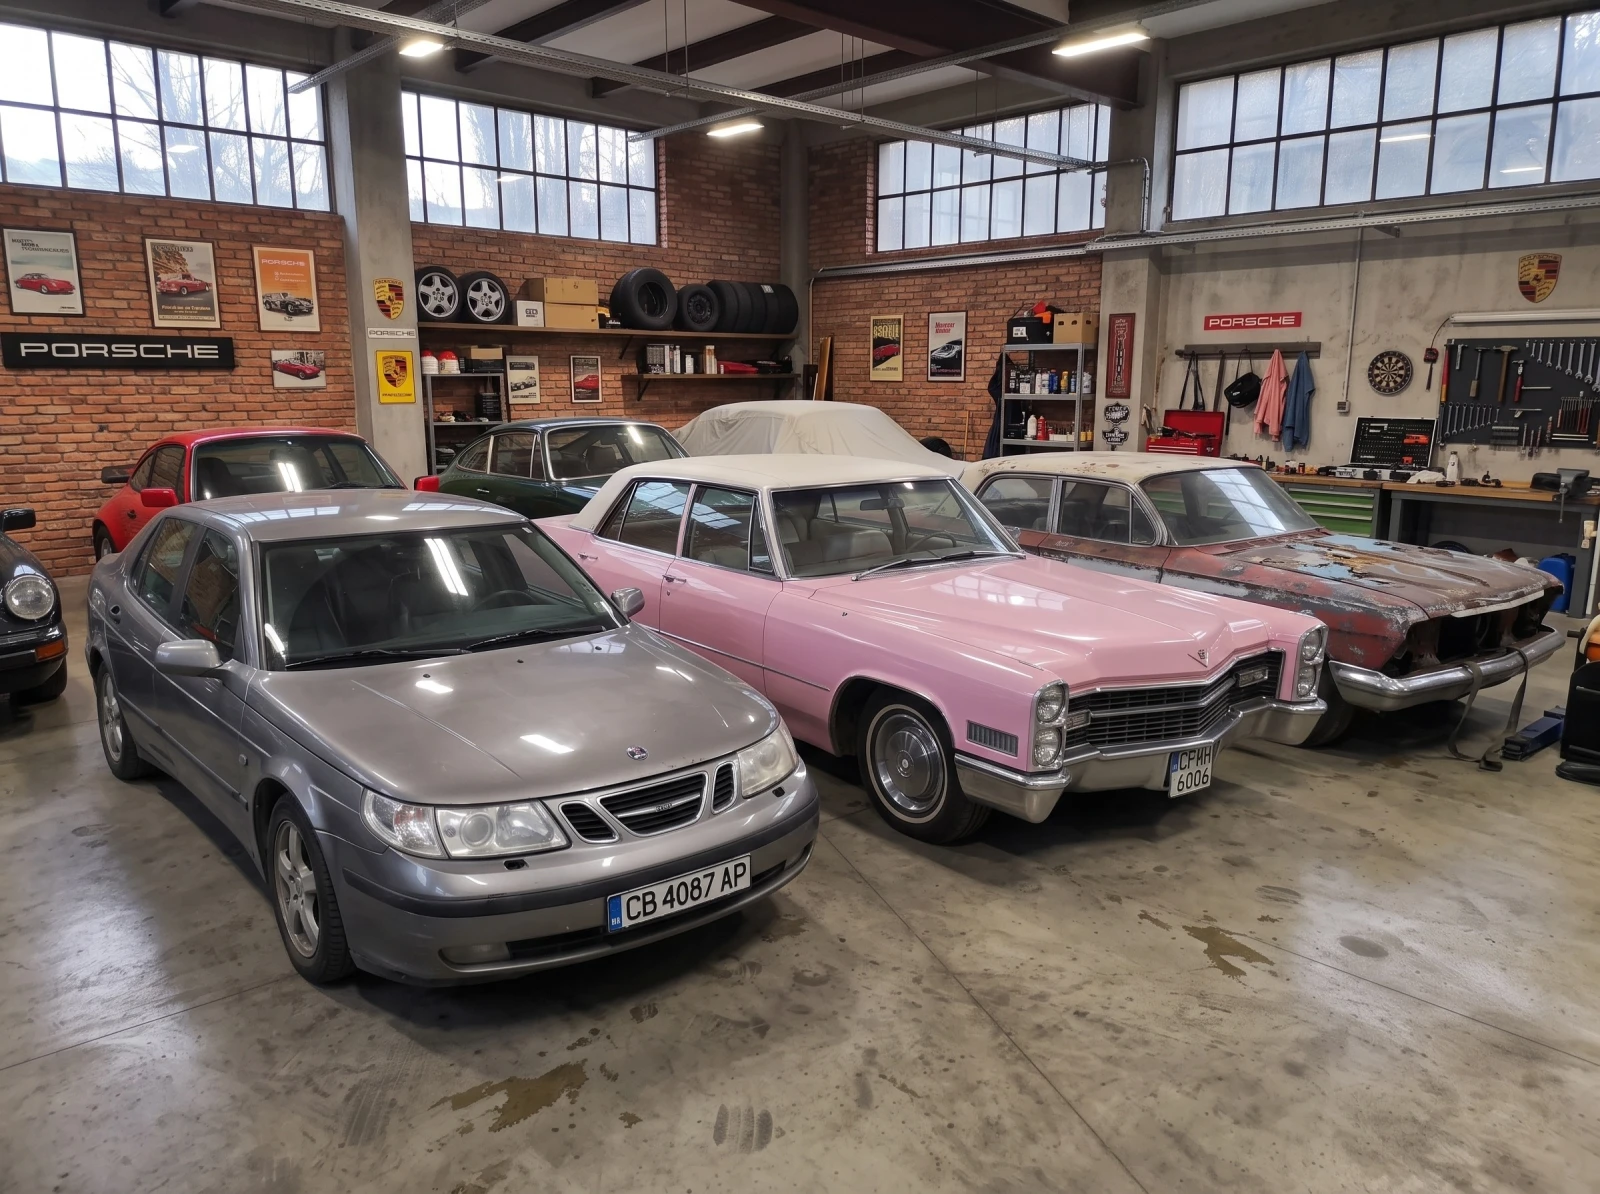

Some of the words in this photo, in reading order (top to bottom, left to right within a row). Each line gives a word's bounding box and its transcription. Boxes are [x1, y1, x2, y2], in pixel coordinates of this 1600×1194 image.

[1208, 315, 1296, 328] PORSCHE
[20, 342, 219, 359] PORSCHE
[1177, 767, 1209, 792] 6006
[626, 890, 657, 921] CB
[662, 871, 715, 909] 4087
[720, 862, 747, 892] AP
